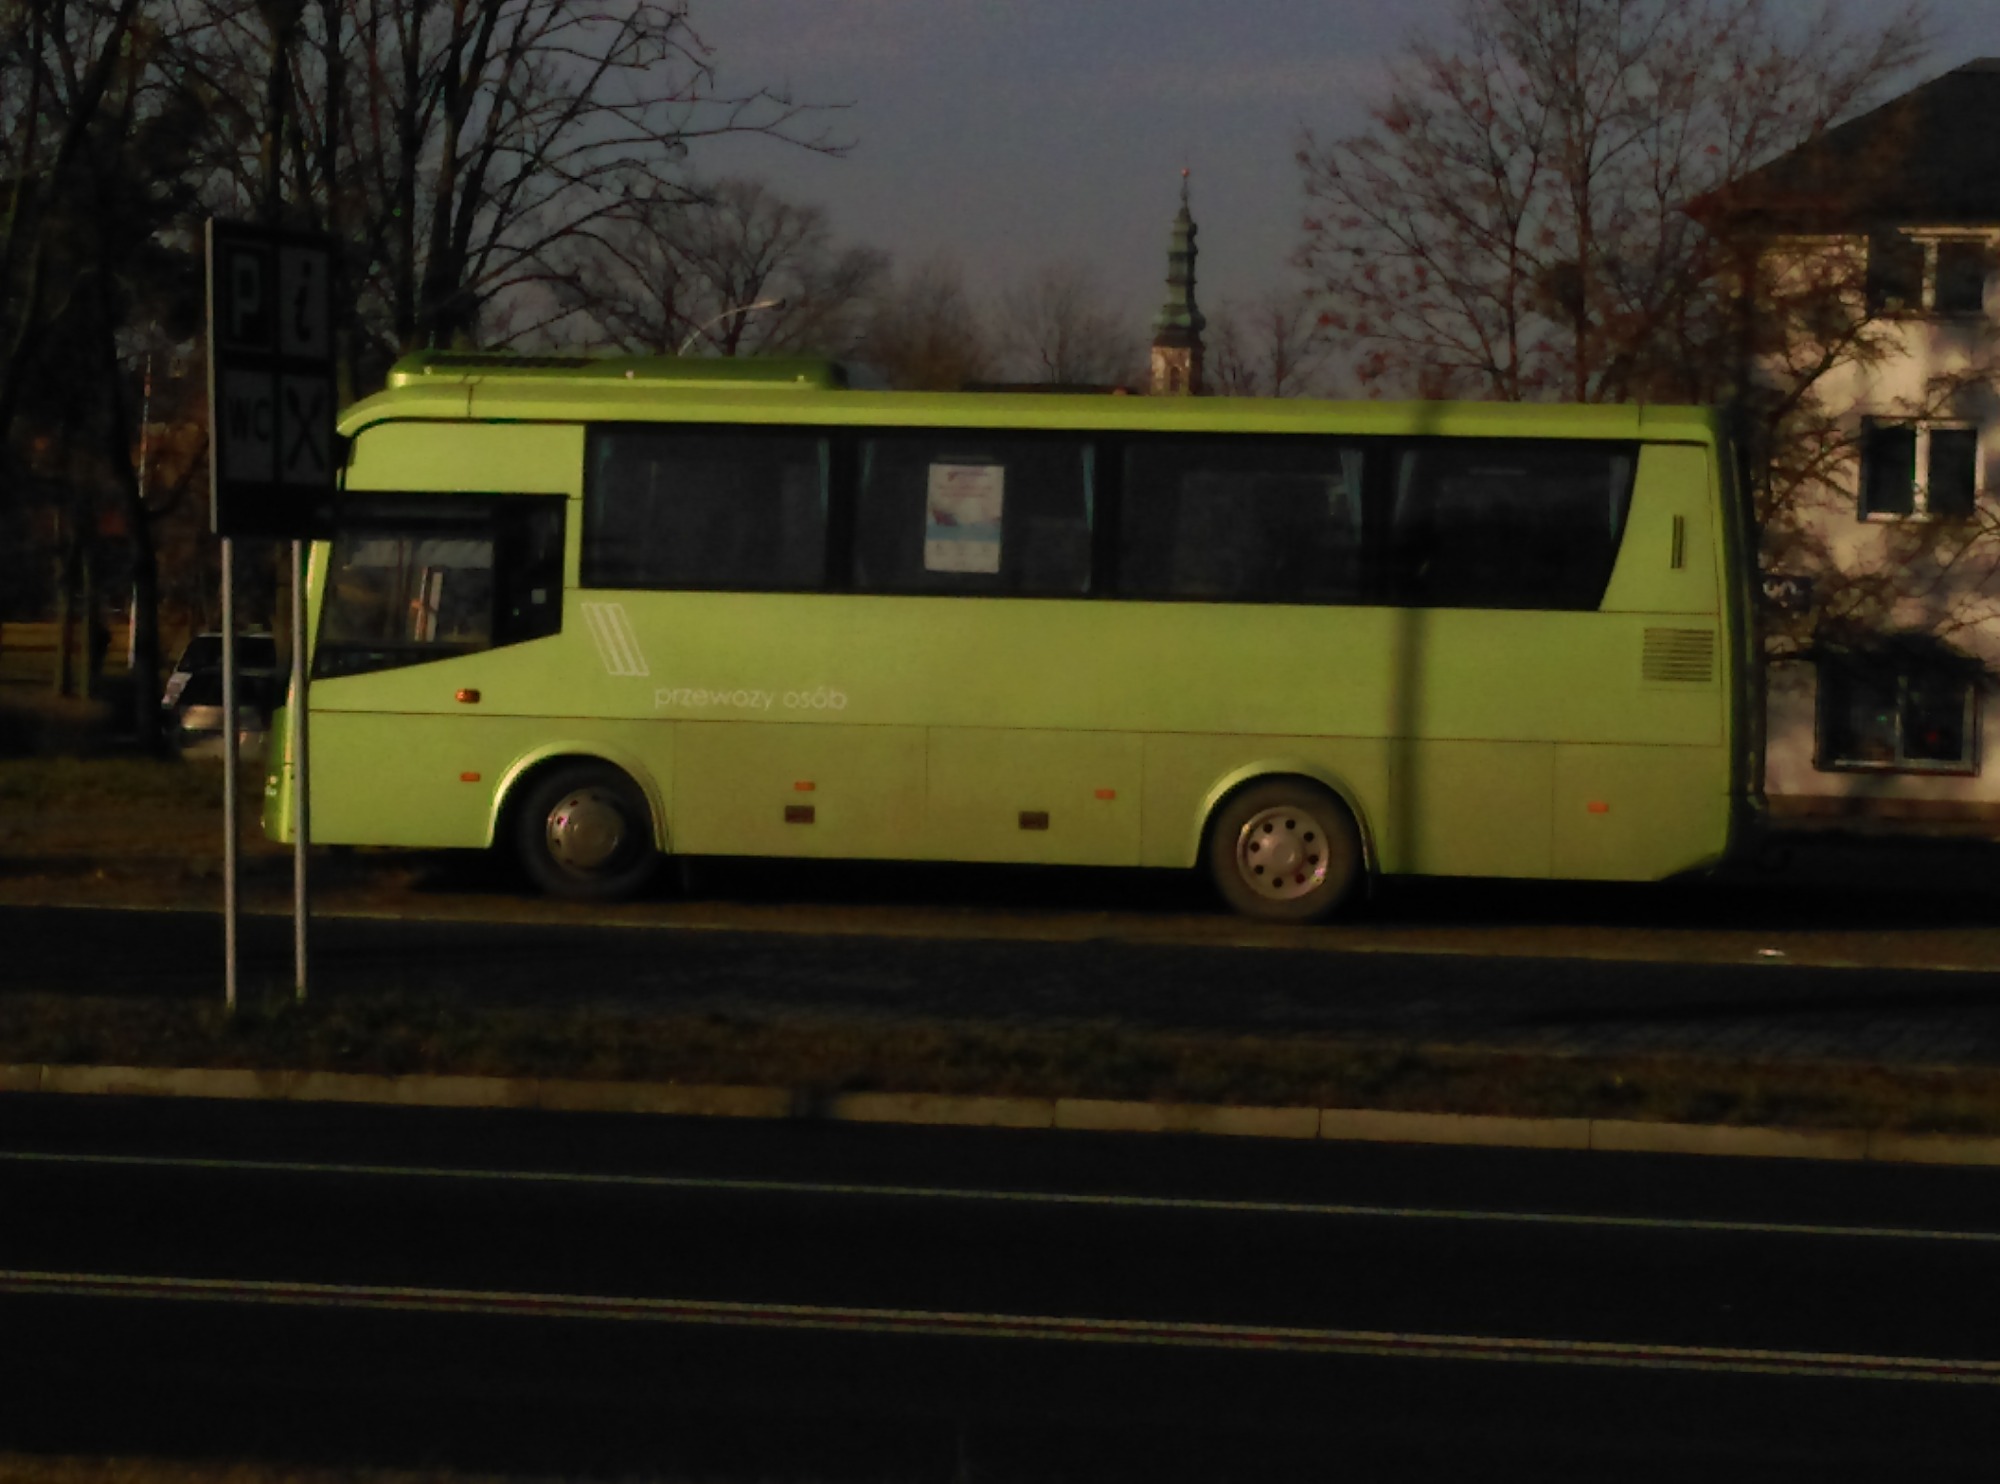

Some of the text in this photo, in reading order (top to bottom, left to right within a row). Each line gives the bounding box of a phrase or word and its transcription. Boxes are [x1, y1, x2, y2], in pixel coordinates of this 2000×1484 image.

[234, 255, 261, 338] P
[294, 260, 311, 343] i
[230, 398, 270, 442] WC
[655, 686, 848, 711] przewozy osób
